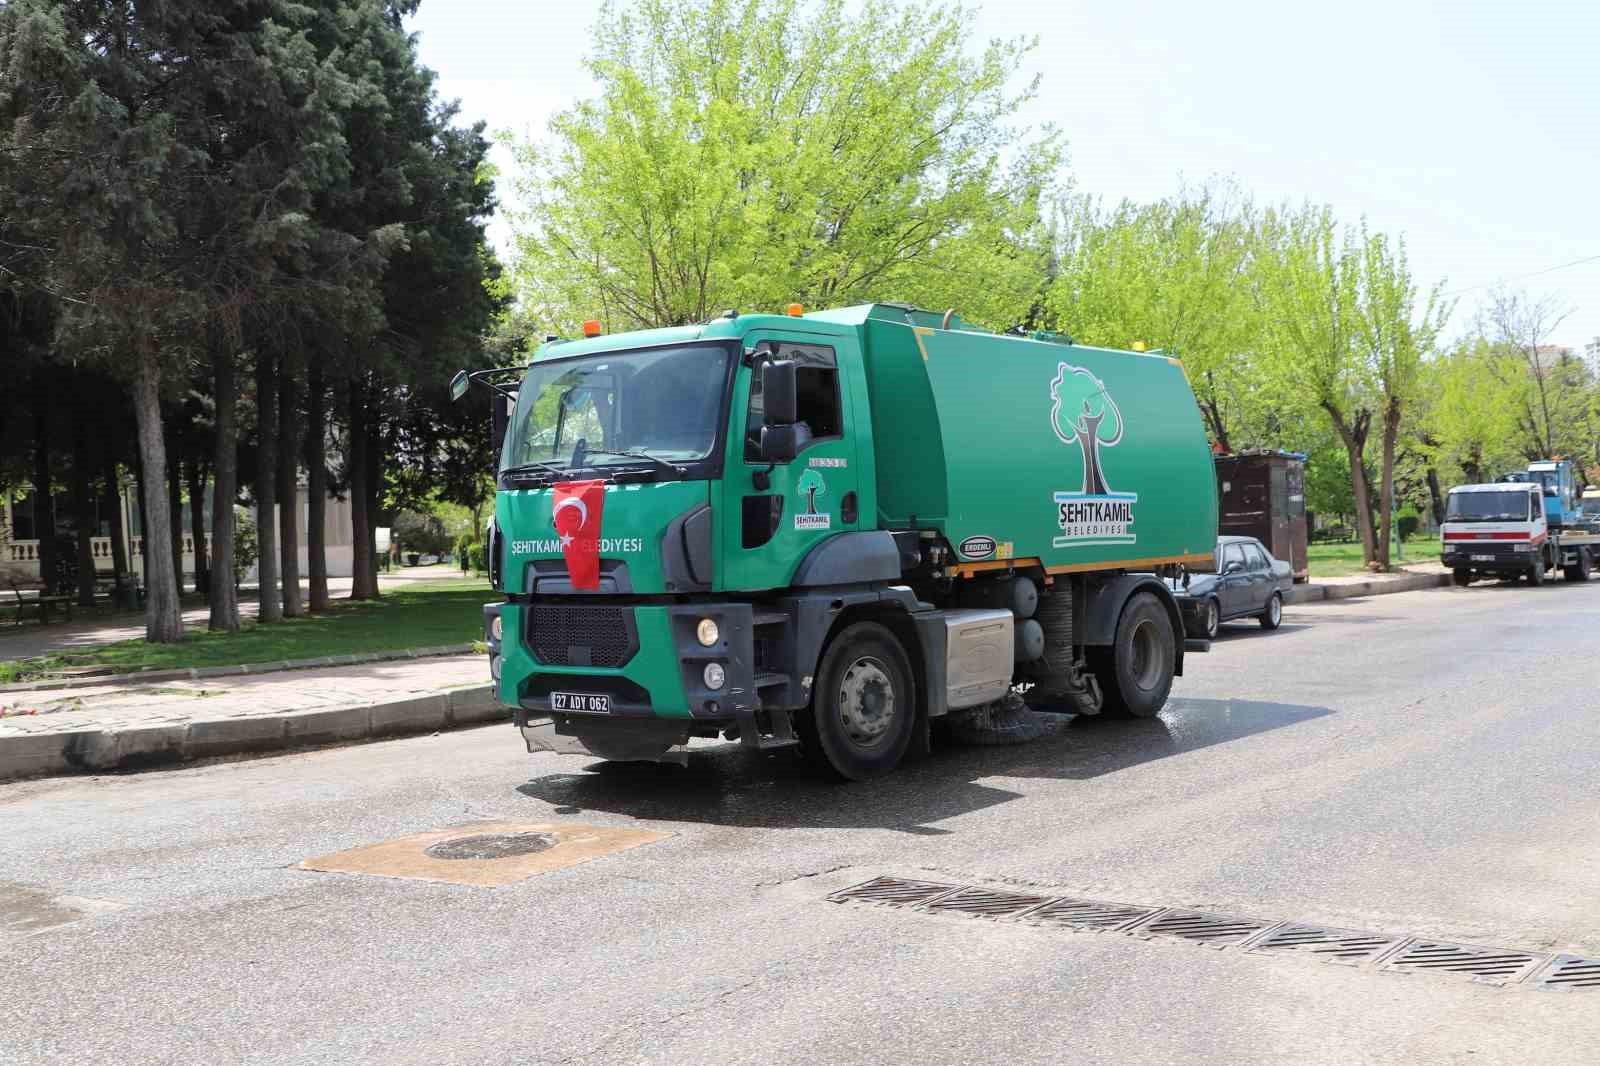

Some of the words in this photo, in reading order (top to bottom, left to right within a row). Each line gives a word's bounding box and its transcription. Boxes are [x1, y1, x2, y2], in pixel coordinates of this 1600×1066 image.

[556, 695, 567, 708] 27
[570, 695, 586, 709] ADY
[589, 697, 608, 711] 062
